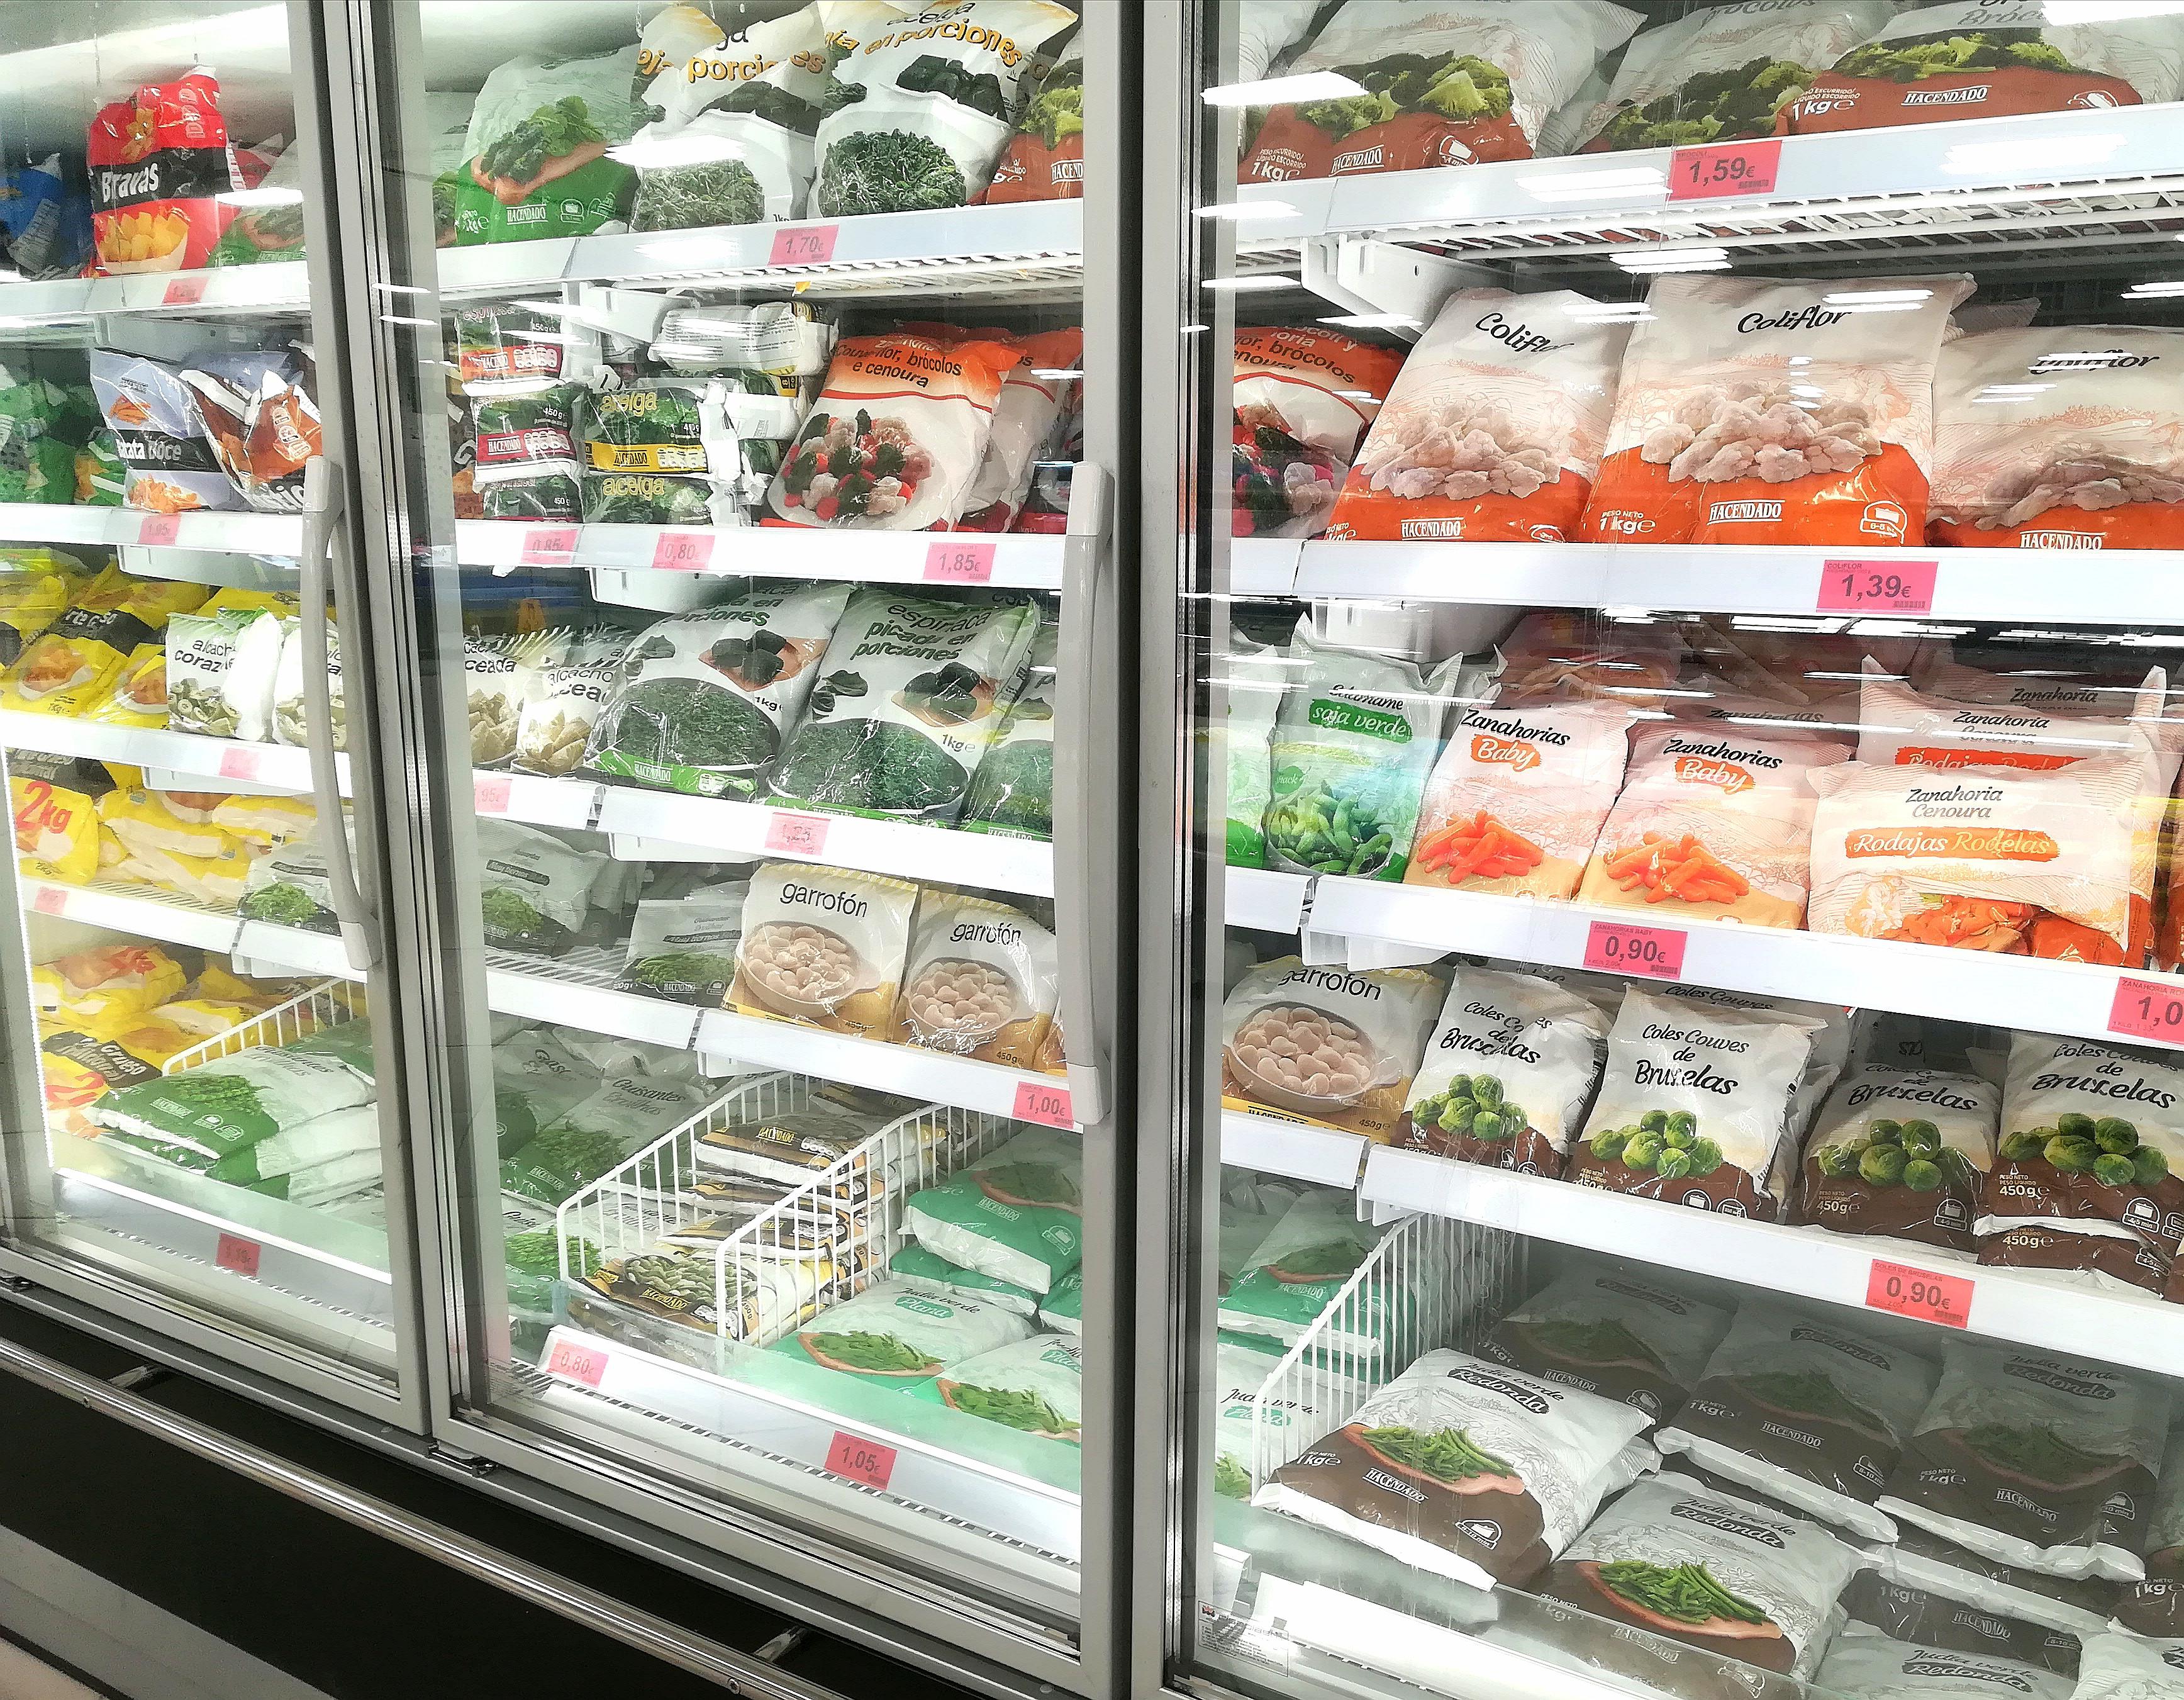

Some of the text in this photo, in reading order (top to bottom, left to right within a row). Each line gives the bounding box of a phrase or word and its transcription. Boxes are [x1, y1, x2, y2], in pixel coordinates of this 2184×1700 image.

[864, 18, 1022, 67] en porciones
[1904, 87, 1988, 104] HACENDADO
[1051, 162, 1083, 182] HACEND
[1333, 146, 1383, 174] HACENDADO
[1689, 157, 1756, 186] 1,59€
[101, 162, 159, 204] Bravas
[506, 206, 547, 224] HACENDADO
[784, 237, 823, 255] 1,70€
[1737, 305, 1852, 333] Coliflor
[906, 352, 962, 377] brócolos
[1234, 350, 1296, 370] enoura
[1269, 340, 1356, 383] brócolos
[852, 361, 929, 389] e cenoura
[599, 391, 657, 417] acelga
[148, 440, 181, 461] Doce
[602, 476, 664, 500] acelga
[1623, 510, 1644, 518] NETO
[1710, 502, 1782, 521] HACENDADO
[1401, 523, 1461, 537] HACENDADO
[2020, 533, 2103, 550] HACENDADO
[939, 552, 981, 573] 1,85€
[1842, 574, 1911, 601] 1,39€
[888, 603, 992, 632] espinaca
[850, 640, 960, 661] porciones
[951, 631, 978, 648] en
[2009, 687, 2098, 704] Zanahoria
[1312, 705, 1408, 738] soja verde
[1461, 708, 1571, 747] Zanahorias
[1953, 710, 2051, 729] Zanahoria
[1476, 739, 1535, 771] Baby
[1664, 739, 1783, 769] Zanahorias
[1681, 758, 1748, 791] Baby
[1906, 784, 2003, 803] Zanahoria
[1912, 803, 1992, 819] Cenoura
[1851, 834, 2051, 857] Rodajas Rodelas
[780, 882, 868, 918] garrofón
[950, 921, 1022, 946] garrofón
[1605, 936, 1666, 963] 0,90€
[1278, 969, 1382, 1000] garrofón
[1664, 985, 1708, 1000] Coles
[2122, 980, 2168, 994] ZANAHORIA
[1464, 1001, 1505, 1022] Coles
[2138, 996, 2184, 1026] 1,0
[1642, 1024, 1750, 1054] Coles Couves
[1673, 1046, 1696, 1063] de
[2053, 1044, 2103, 1060] Coles
[2095, 1061, 2124, 1076] de
[612, 1078, 686, 1103] Guisantes
[1847, 1083, 1978, 1112] Bruxelas
[2032, 1073, 2176, 1109] Bruxelas
[1027, 1094, 1066, 1116] 1,00€
[978, 1197, 1023, 1222] HACENDADO
[640, 1287, 688, 1311] HACENDADO
[1886, 1276, 1951, 1310] 0,90€
[900, 1298, 952, 1317] Plana
[1450, 1370, 1550, 1413] Redonda
[1513, 1377, 1564, 1401] verde
[1543, 1370, 1597, 1392] HACENDADO
[1763, 1423, 1822, 1448] HACENDADO
[842, 1446, 881, 1472] 1,05€
[1364, 1470, 1425, 1502] HACENDADO
[1997, 1489, 2058, 1522] HACENDADO
[1672, 1506, 1788, 1549] Redonda
[1735, 1511, 1798, 1536] verde
[1954, 1613, 2012, 1638] HACENDADO
[1909, 1662, 2029, 1692] Redonda
